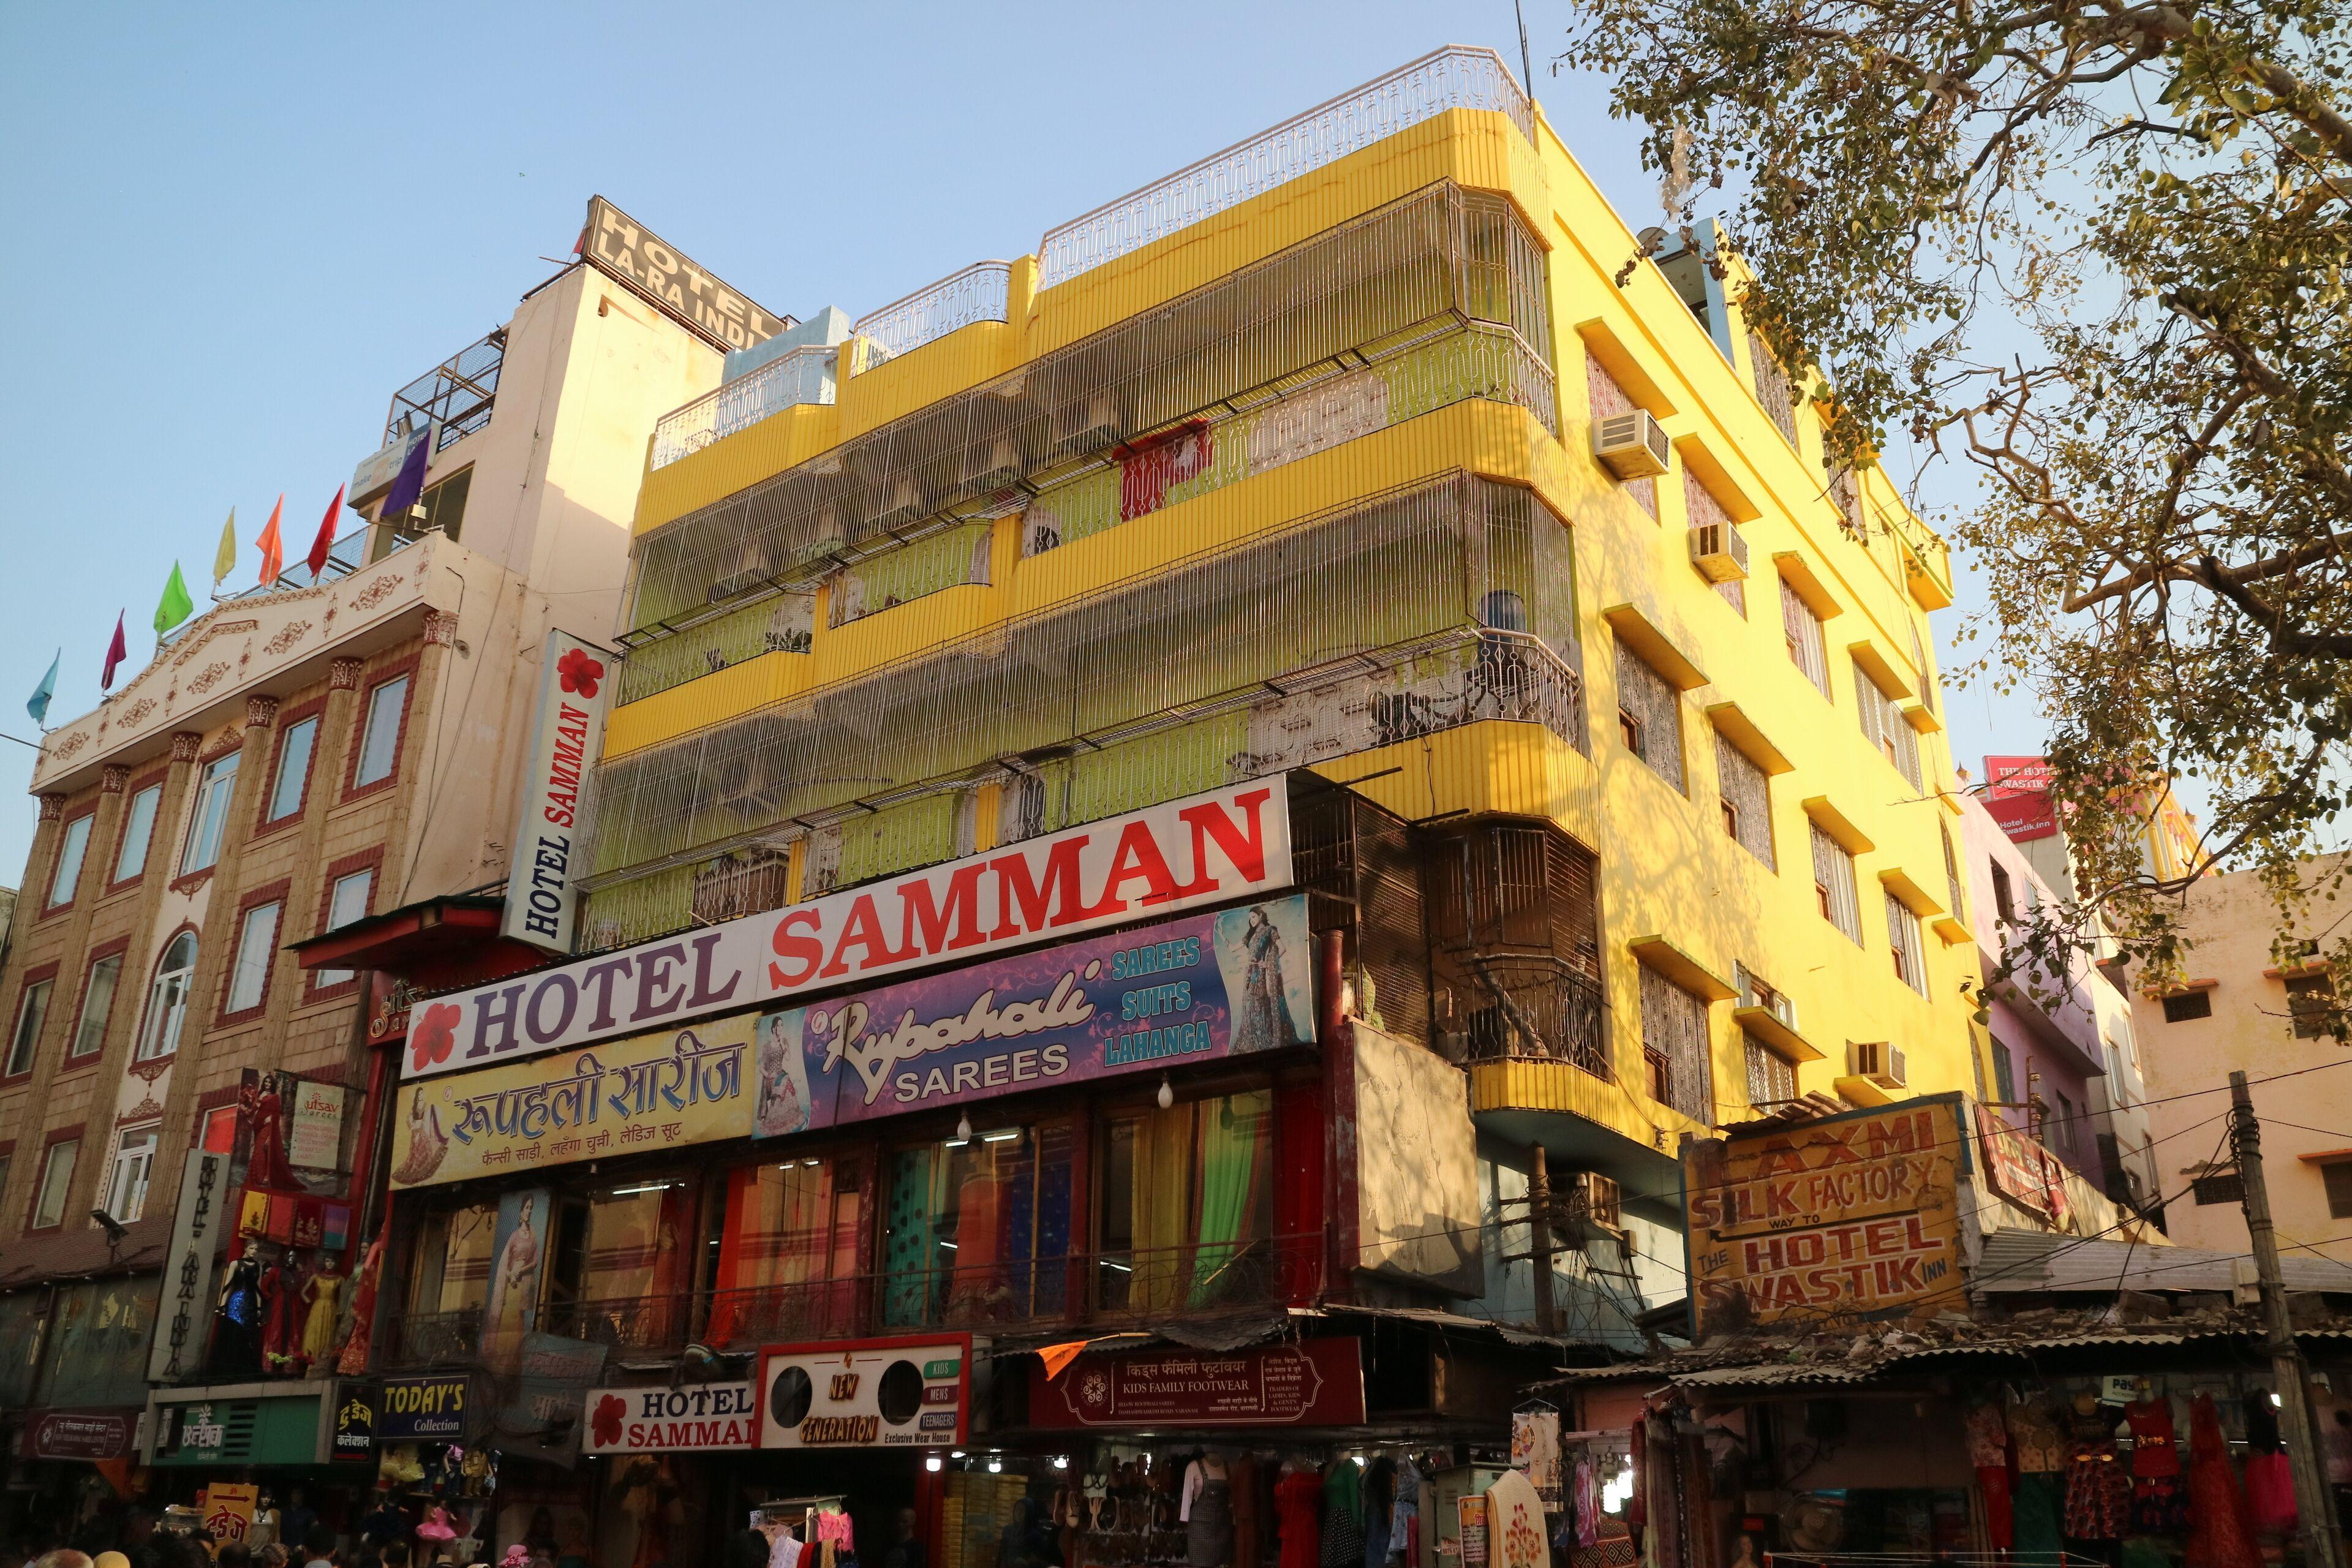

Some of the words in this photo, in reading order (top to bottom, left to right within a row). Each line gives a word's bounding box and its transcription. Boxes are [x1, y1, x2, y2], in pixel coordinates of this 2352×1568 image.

[602, 209, 772, 340] HOTEL
[598, 232, 685, 311] LA-RA
[695, 299, 764, 350] INDI
[544, 703, 589, 828] SAMMAN
[526, 835, 570, 939] HOTEL
[466, 932, 742, 1060] HOTEL
[769, 788, 1270, 990] SAMMAN
[1112, 936, 1200, 981] SAREES
[1121, 981, 1191, 1021] SUITS
[1104, 1021, 1212, 1067] LAHANGA
[895, 1044, 1069, 1102] SAREES
[1809, 1158, 1936, 1210] FACTORY
[1769, 1216, 1795, 1230] WAY
[1802, 1215, 1820, 1225] TO
[1743, 1215, 1943, 1274] HOTEL
[1697, 1250, 1728, 1272] THE
[1921, 1257, 1947, 1284] INN
[933, 1362, 949, 1374] KIDS
[384, 1384, 464, 1415] TODAY'S
[828, 1374, 860, 1401] NEW
[930, 1388, 948, 1401] MENS
[1123, 1383, 1147, 1393] KIDS
[1149, 1382, 1185, 1393] FAMILY
[1188, 1380, 1250, 1392] FOOTWEAR
[641, 1388, 755, 1418] HOTEL
[414, 1418, 459, 1431] Collection
[799, 1415, 880, 1443] GENERATION
[922, 1414, 954, 1427] TEENAGERS
[884, 1433, 913, 1444] Exclusive
[914, 1433, 930, 1443] Wear
[932, 1432, 950, 1442] House
